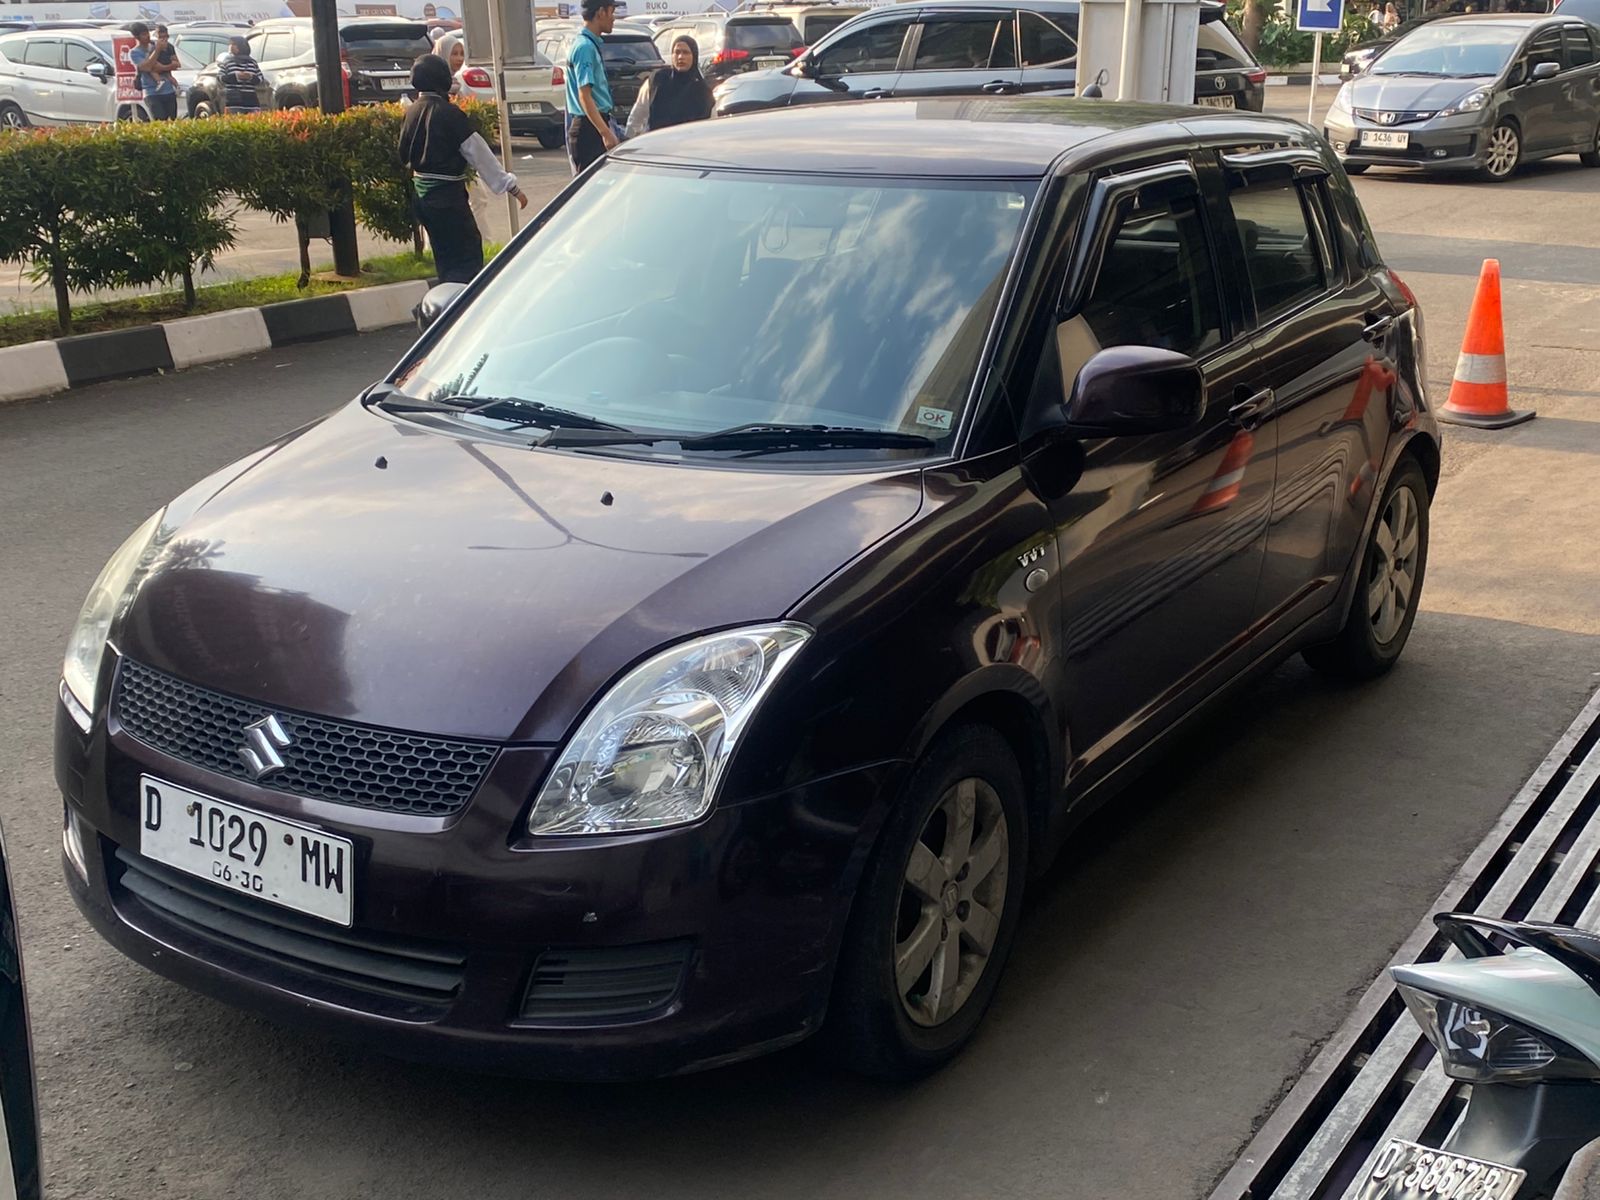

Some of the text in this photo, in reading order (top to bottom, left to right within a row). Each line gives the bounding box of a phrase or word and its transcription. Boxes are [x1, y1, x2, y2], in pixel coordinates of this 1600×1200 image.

[646, 1, 668, 9] RUKO
[1363, 132, 1369, 141] D
[1373, 132, 1392, 142] 1436
[923, 411, 945, 423] OK
[145, 785, 344, 894] D 1029 MW
[1373, 1143, 1402, 1180] D
